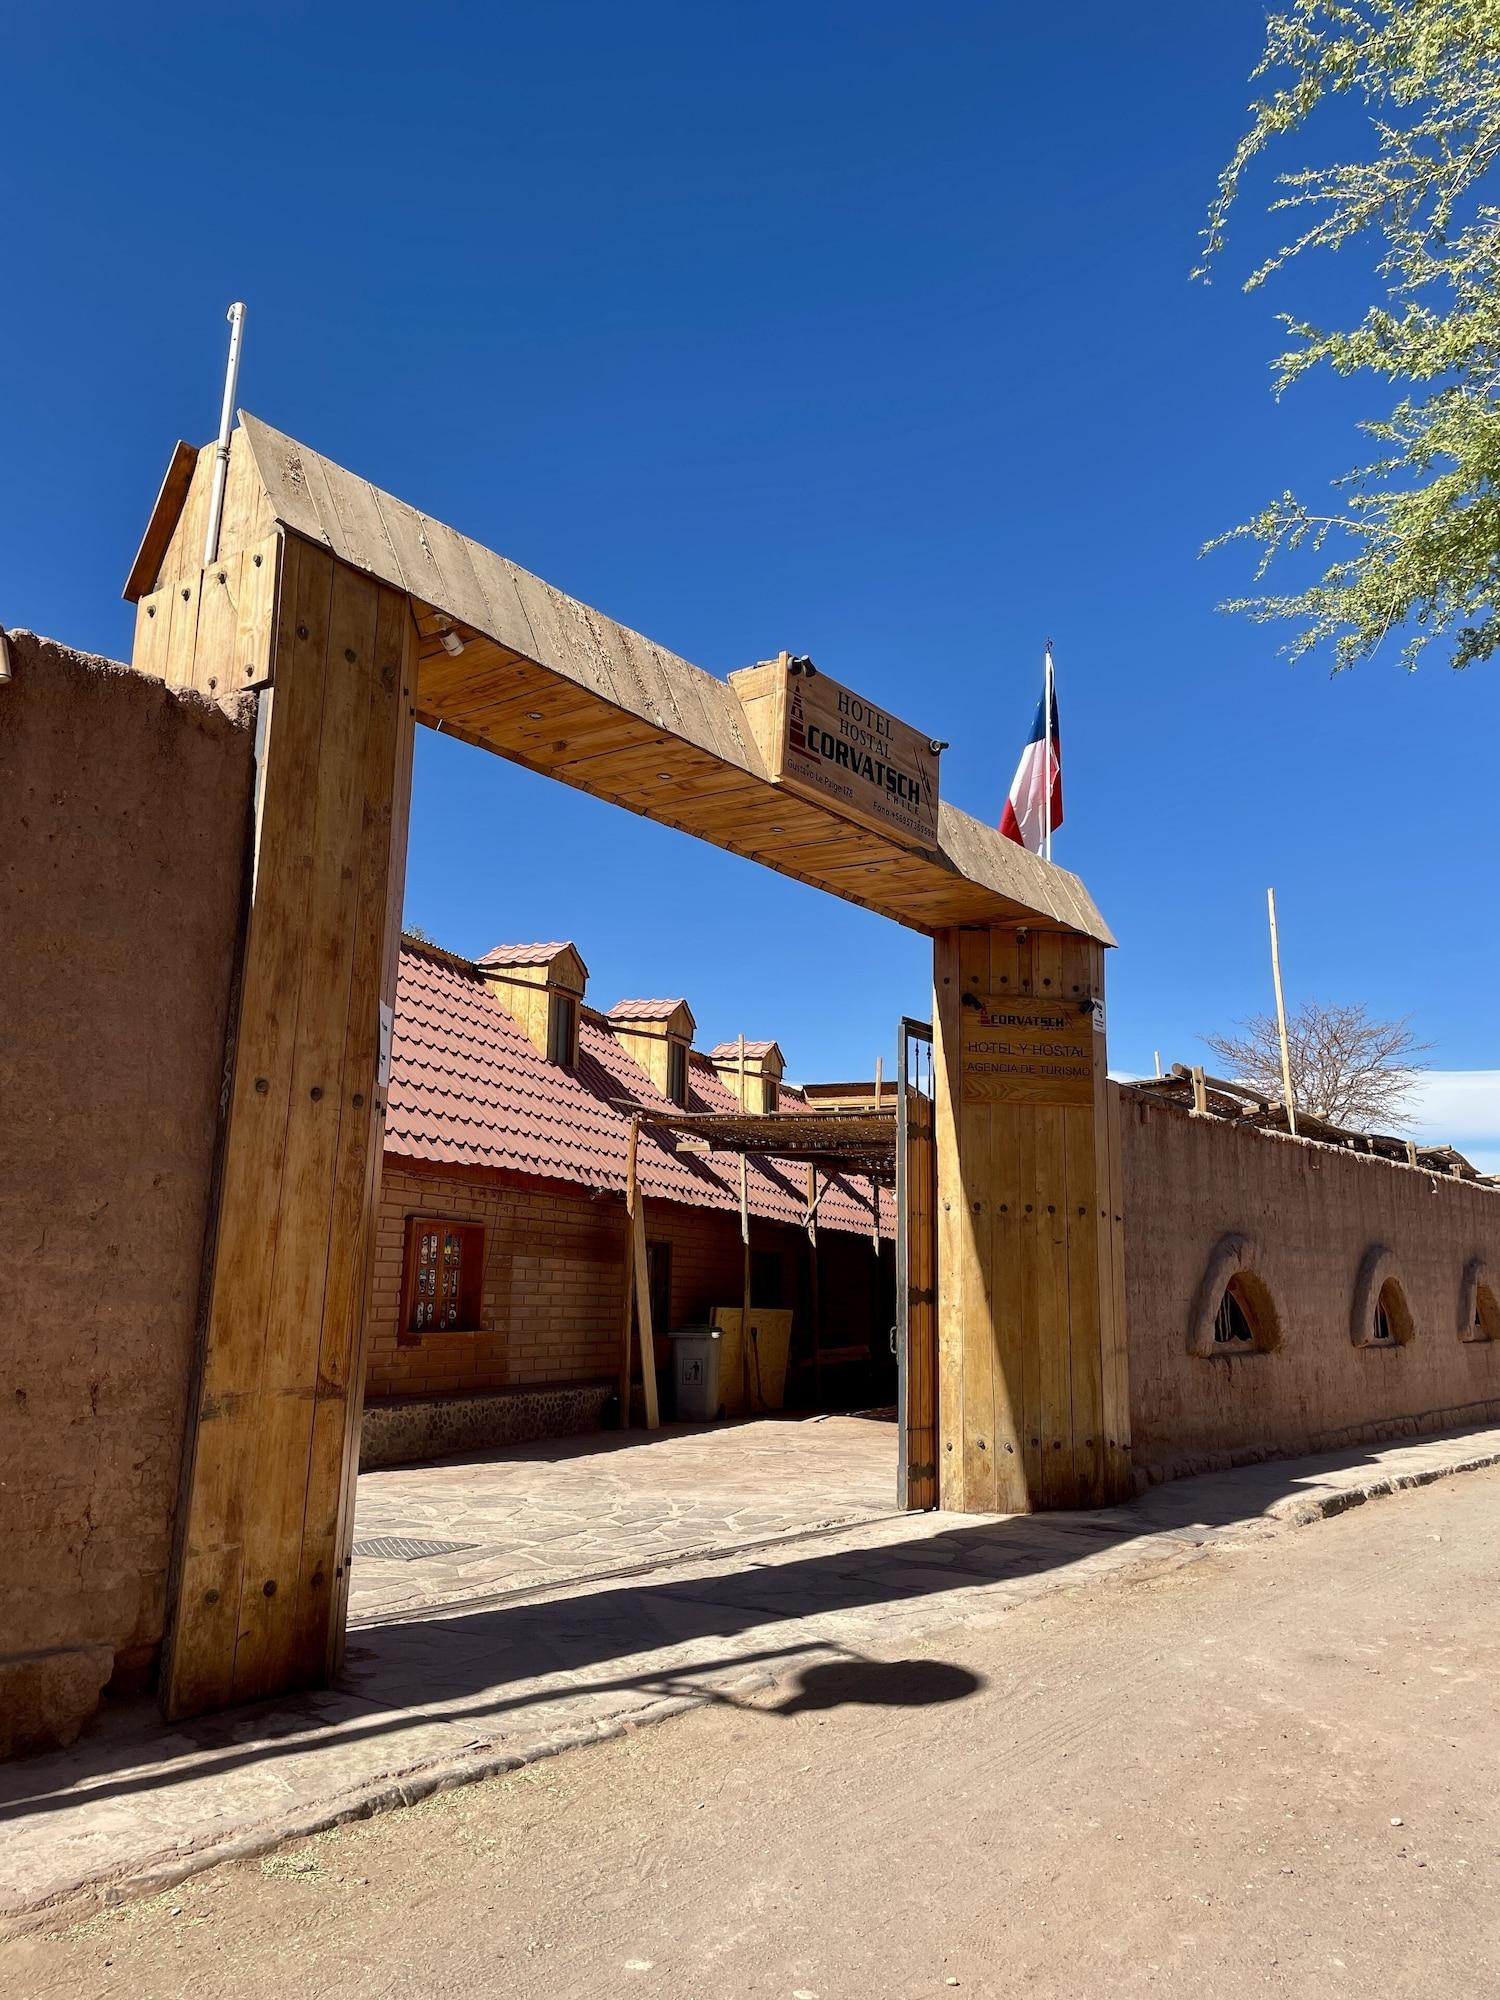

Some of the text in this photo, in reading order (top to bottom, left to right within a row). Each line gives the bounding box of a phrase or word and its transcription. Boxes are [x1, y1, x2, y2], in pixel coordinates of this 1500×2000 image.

[837, 690, 894, 742] HOTEL
[839, 717, 892, 760] HOSTAL
[807, 725, 920, 805] CORVATSCH
[886, 791, 920, 816] CHILE
[990, 1014, 1065, 1027] CORVATSCH
[968, 1041, 1090, 1058] HOTEL Y HOSTAL
[967, 1062, 1090, 1077] AGENCIA DE TURISMO
